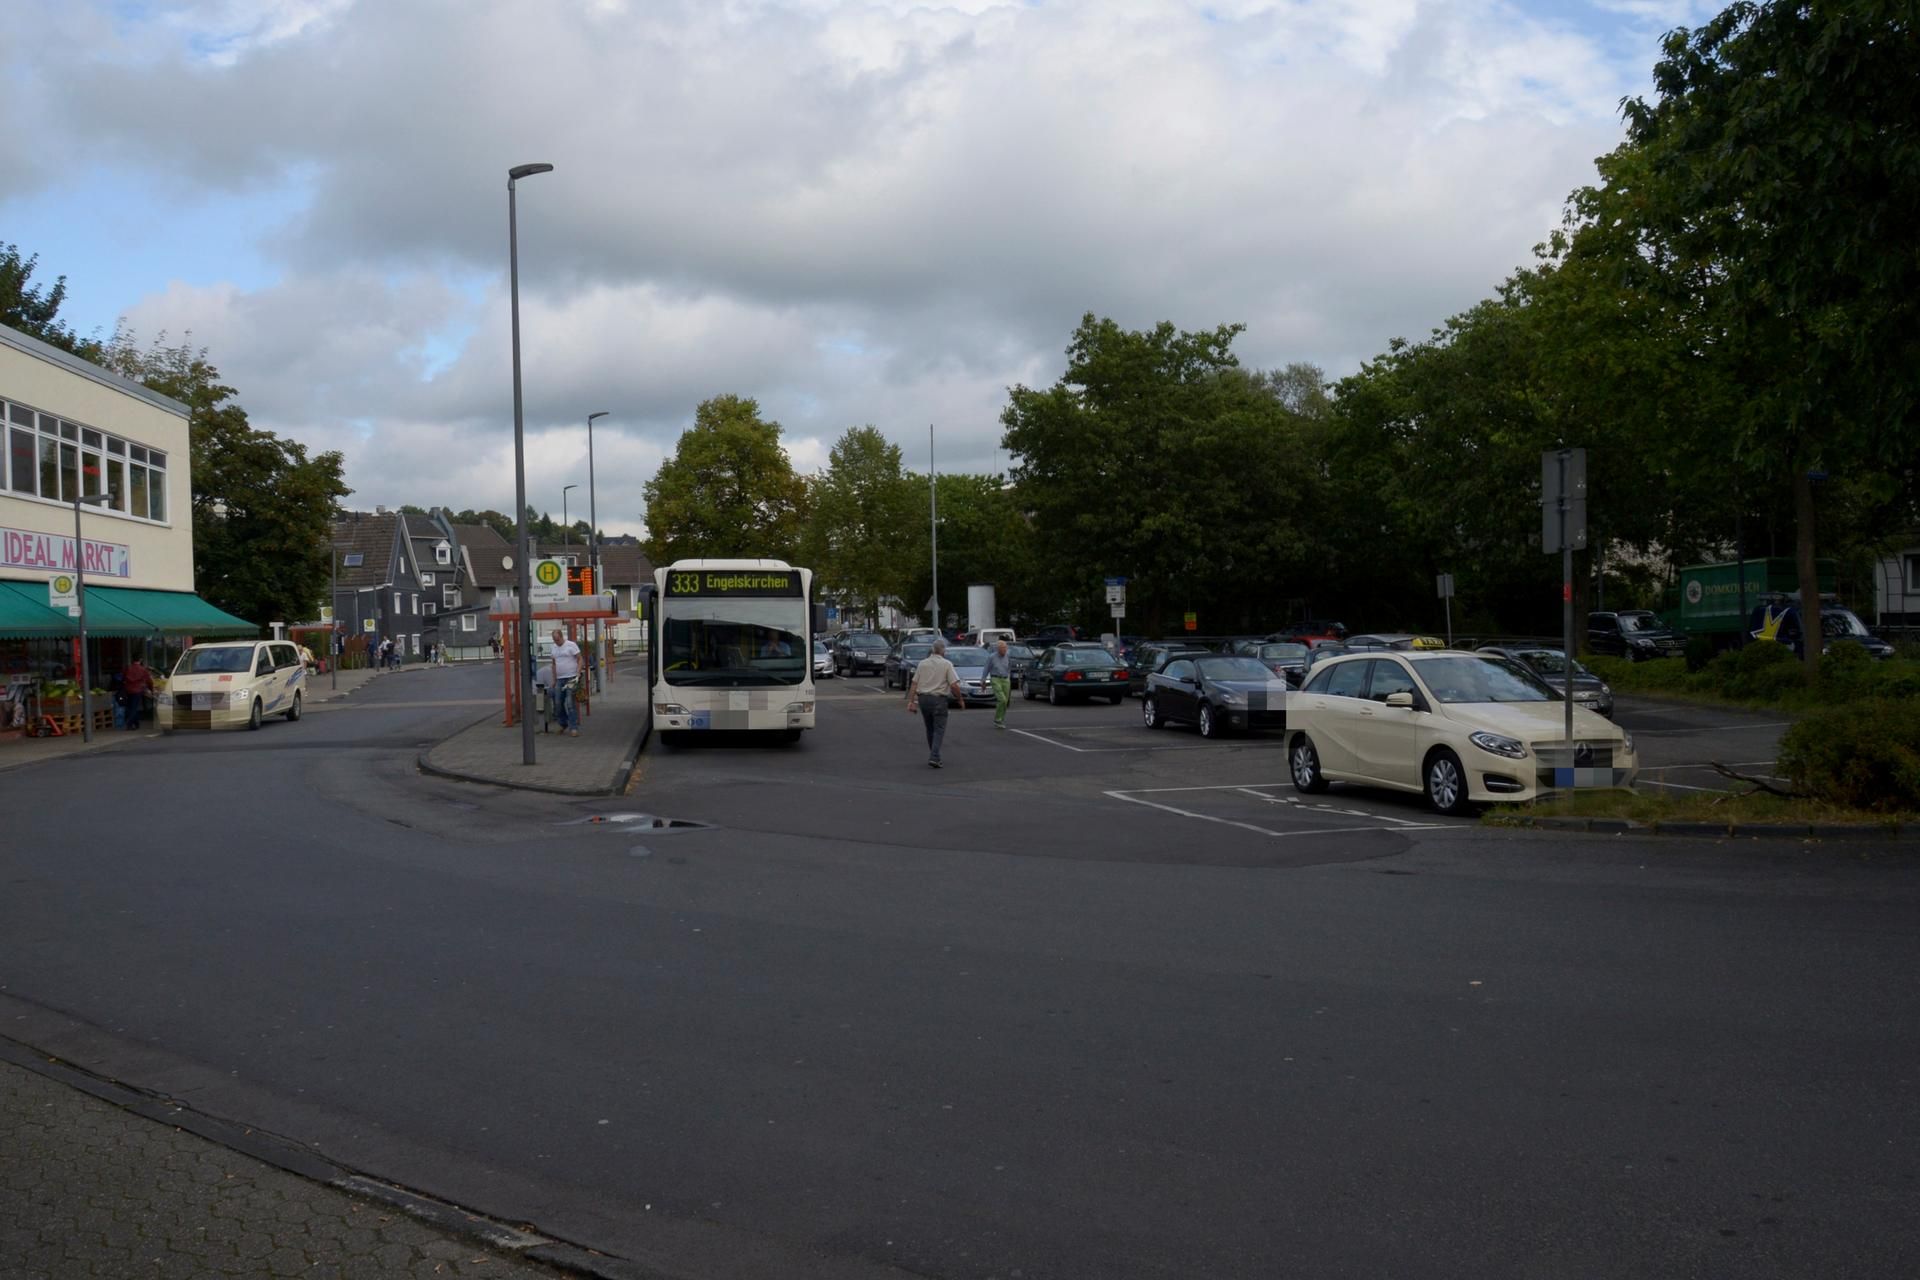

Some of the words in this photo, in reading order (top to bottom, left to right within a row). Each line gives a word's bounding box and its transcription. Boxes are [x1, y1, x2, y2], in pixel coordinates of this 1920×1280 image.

[4, 532, 56, 566] IDEAL
[544, 566, 554, 580] H
[672, 573, 699, 593] 333
[706, 574, 788, 591] Engelskirchen
